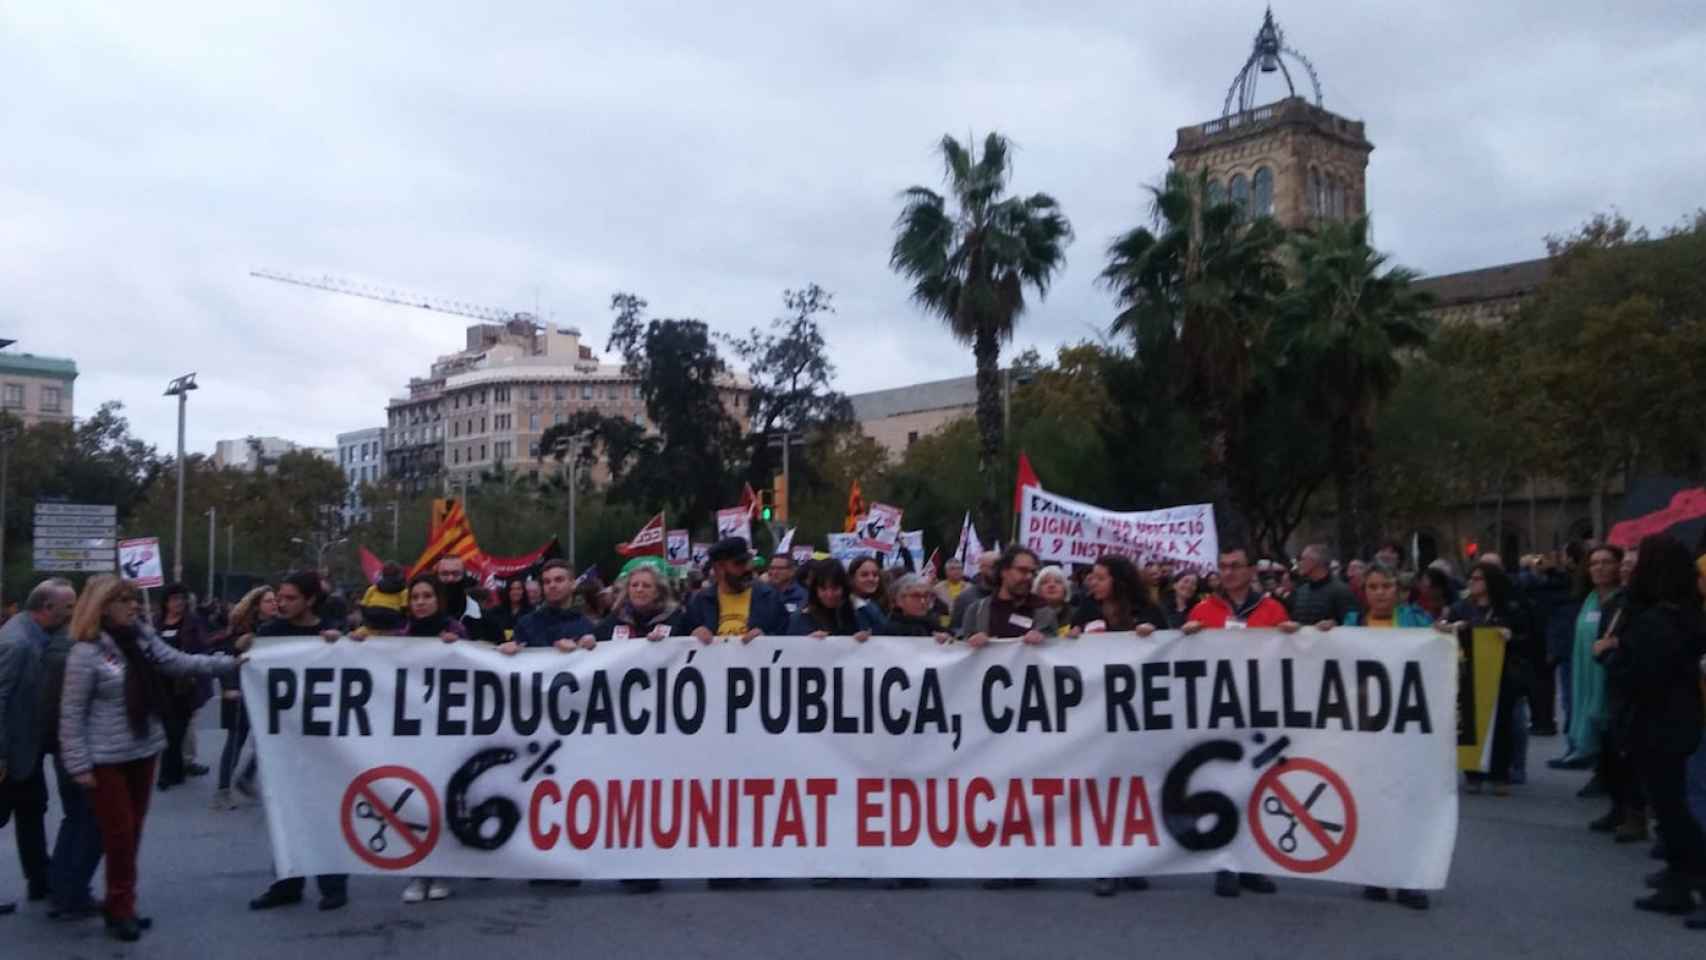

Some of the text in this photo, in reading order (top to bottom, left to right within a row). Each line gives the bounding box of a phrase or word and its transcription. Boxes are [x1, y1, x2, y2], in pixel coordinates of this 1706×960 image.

[1029, 516, 1084, 537] DIGNA
[1185, 539, 1204, 557] X
[1051, 538, 1063, 554] 9
[268, 667, 373, 736] PER
[393, 651, 706, 737] L'EDUCACIÓ
[726, 650, 961, 751] PÚBLICA,
[981, 665, 1084, 734] CAP
[1106, 659, 1433, 734] RETALLADA
[529, 777, 1159, 851] COMUNITAT EDUCATIVA
